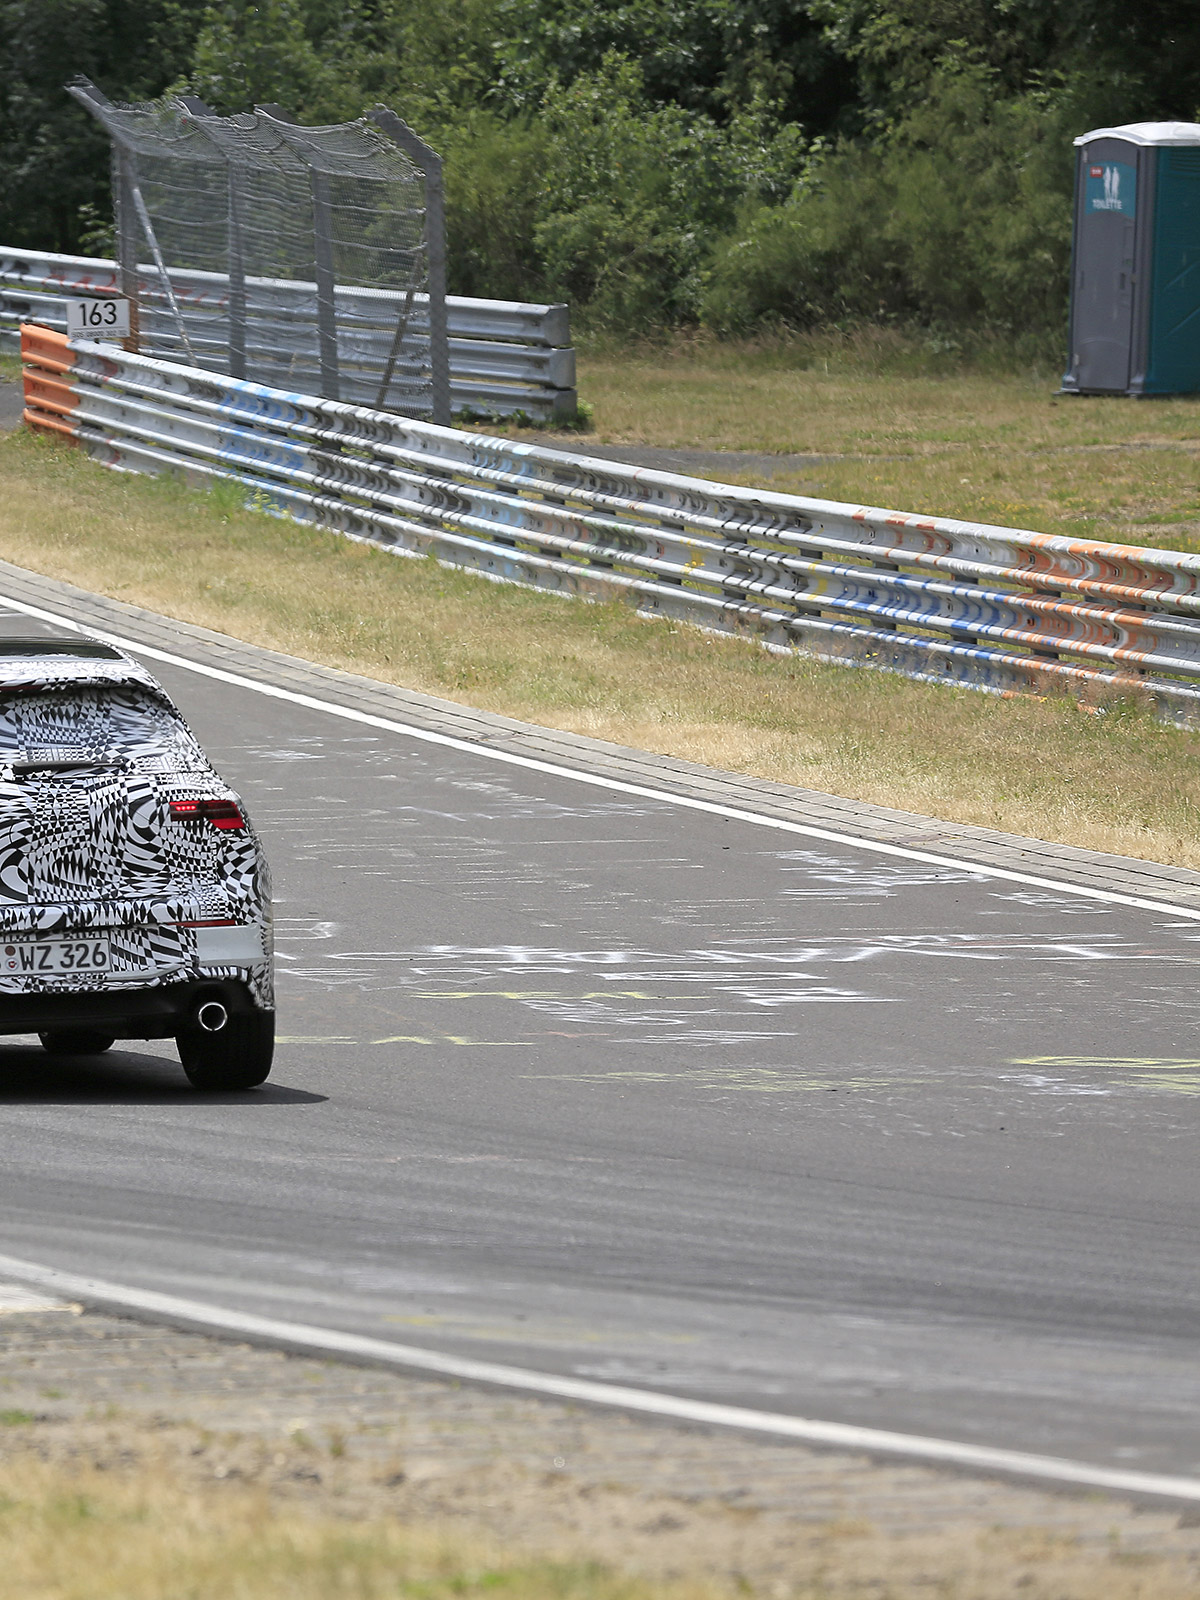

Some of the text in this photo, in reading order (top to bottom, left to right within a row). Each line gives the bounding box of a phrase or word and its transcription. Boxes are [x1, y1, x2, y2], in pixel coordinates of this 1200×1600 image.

[78, 301, 117, 326] 163
[18, 945, 54, 971] WZ
[59, 942, 107, 969] 326
